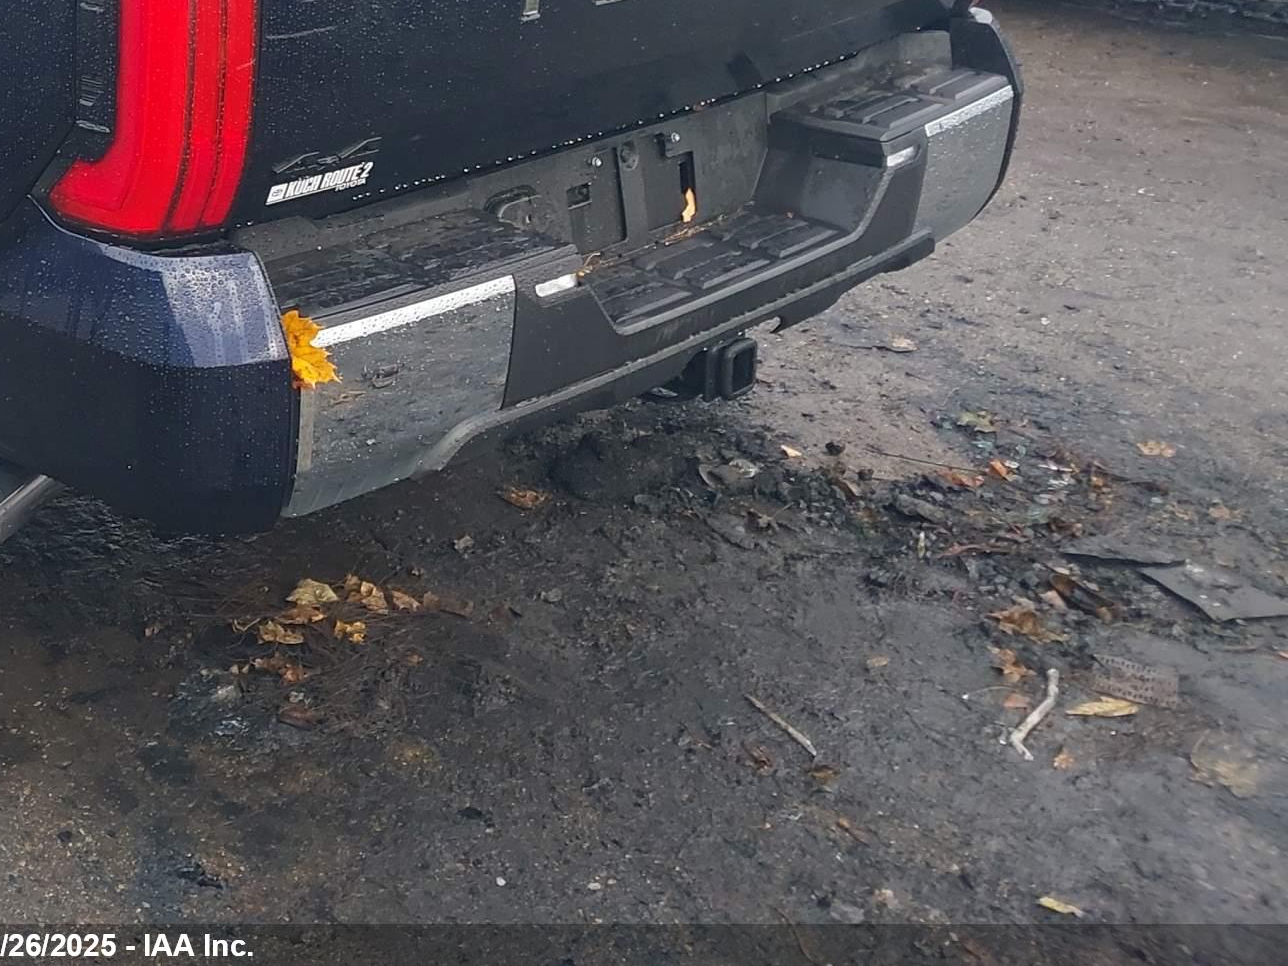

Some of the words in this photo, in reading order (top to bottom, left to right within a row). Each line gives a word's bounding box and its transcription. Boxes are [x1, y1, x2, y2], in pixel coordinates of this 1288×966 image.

[320, 164, 363, 189] ROUTE
[360, 161, 374, 179] 2
[334, 178, 367, 192] TOYOTA
